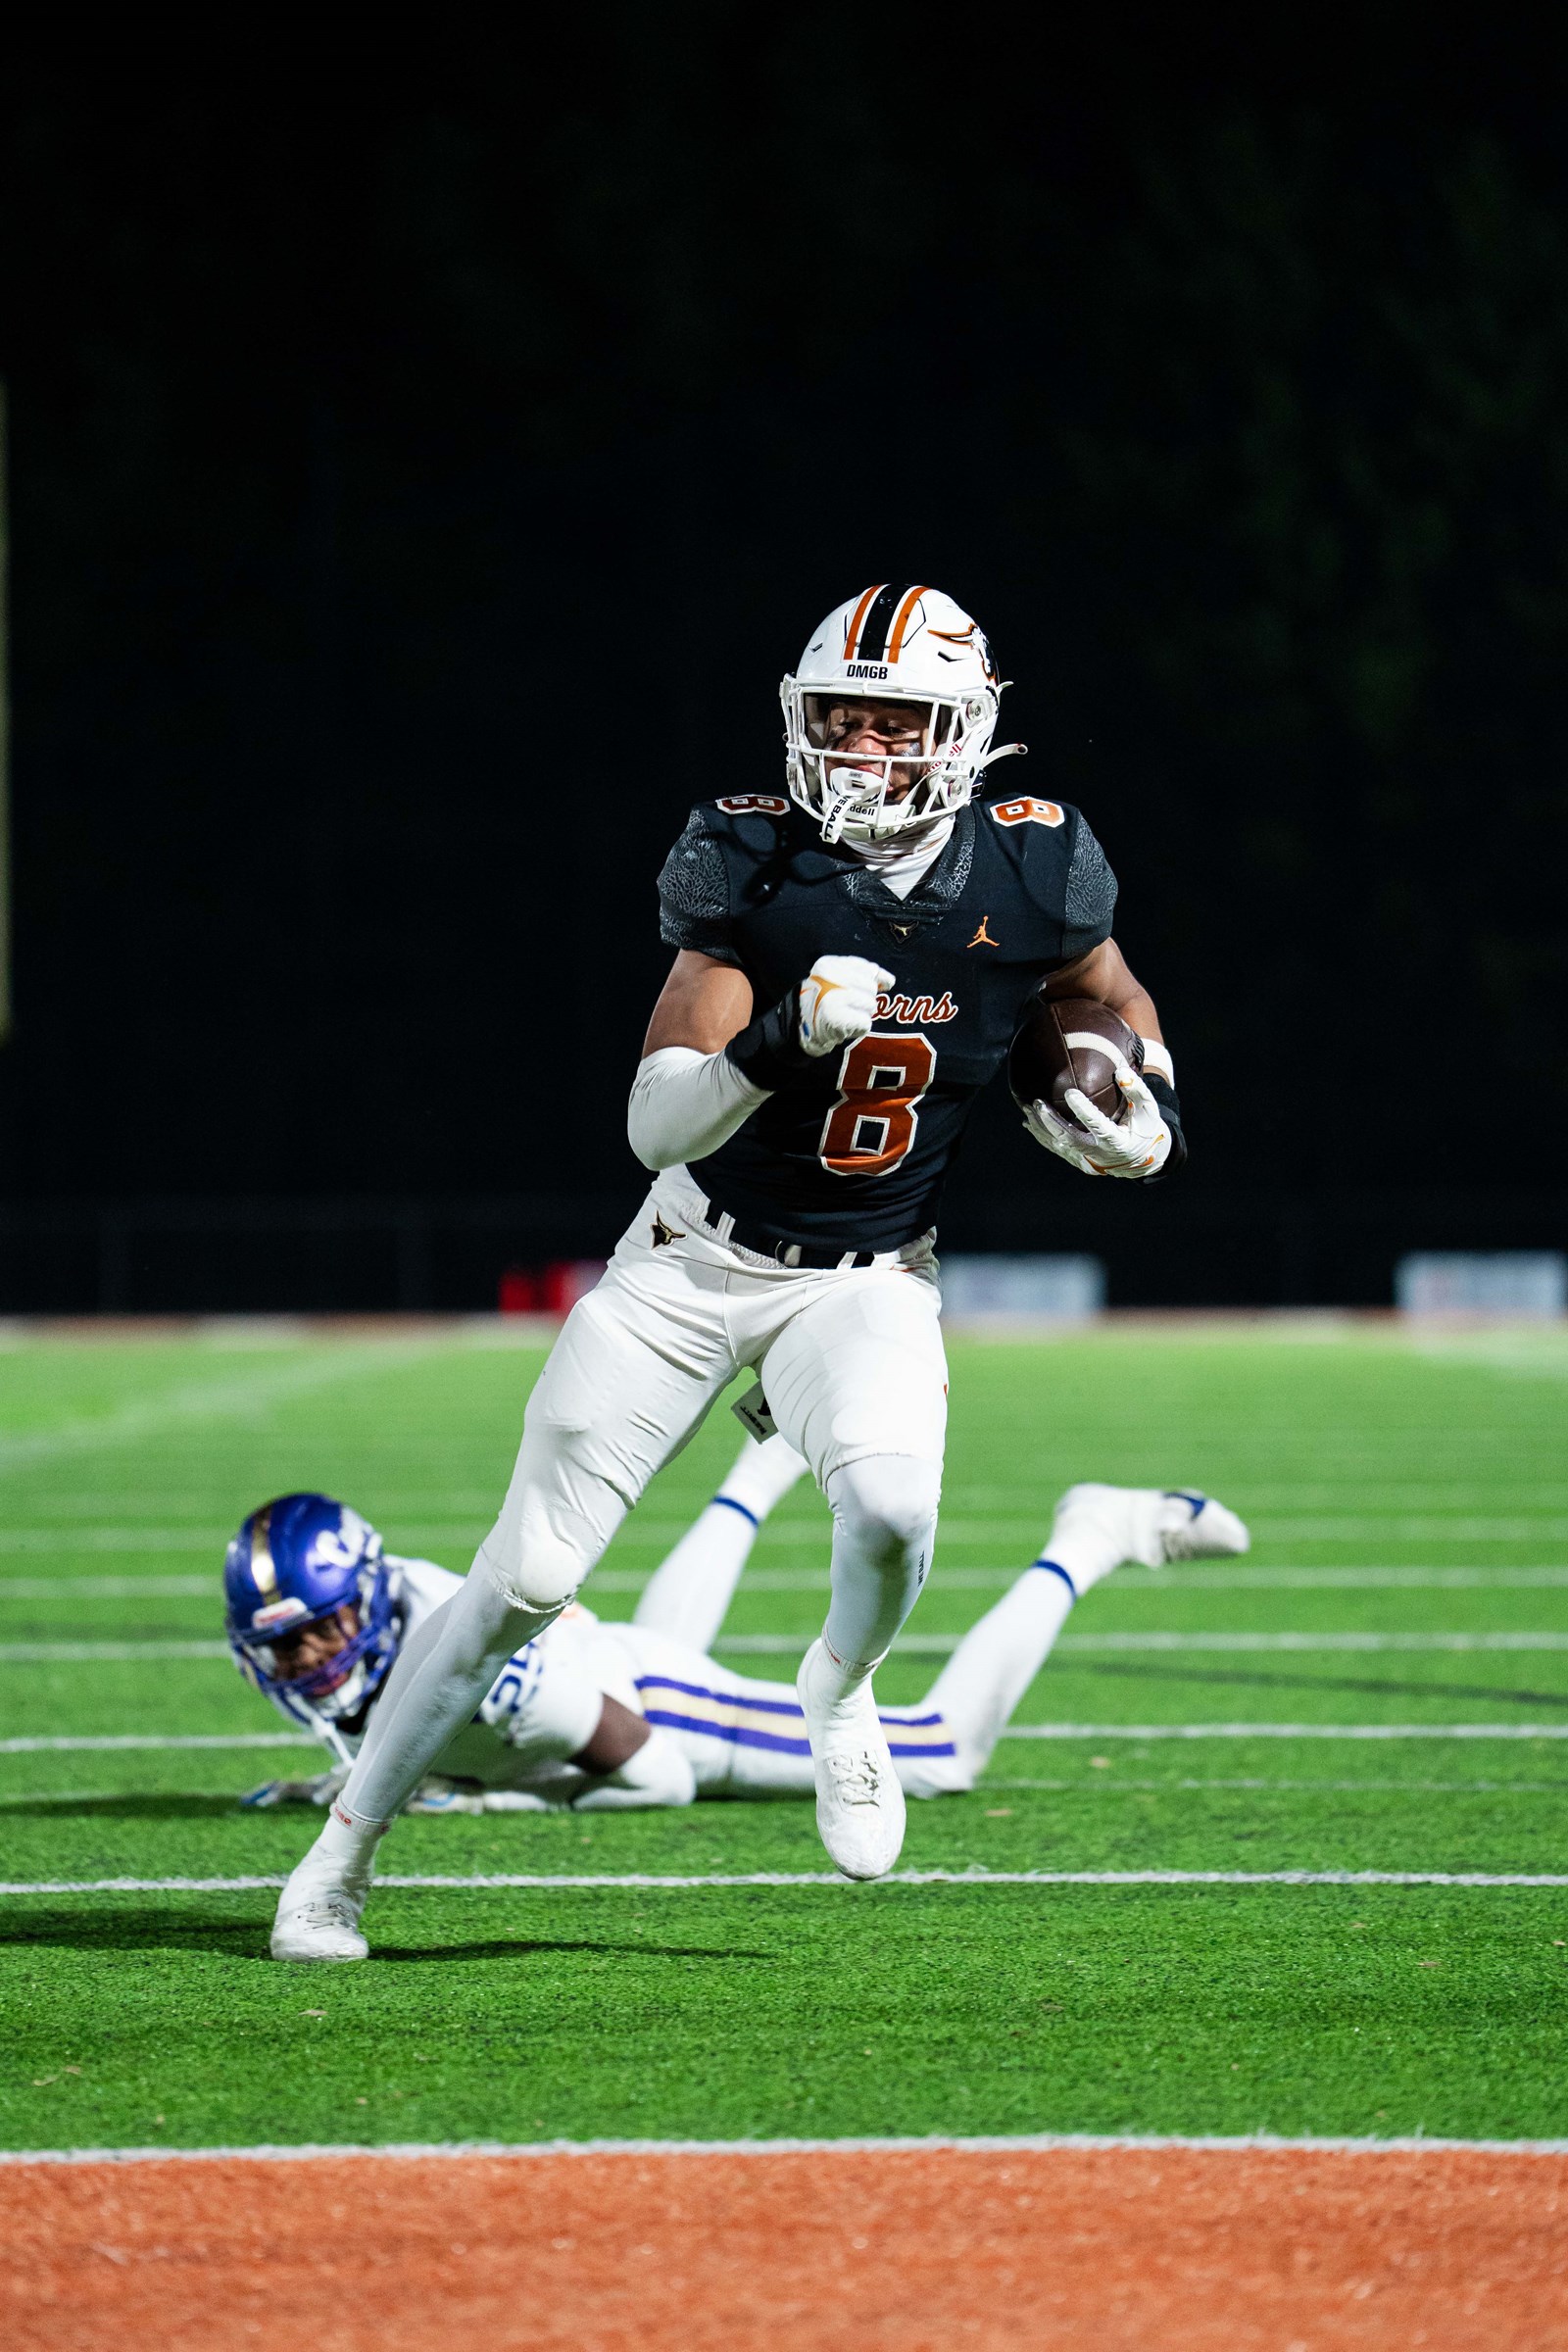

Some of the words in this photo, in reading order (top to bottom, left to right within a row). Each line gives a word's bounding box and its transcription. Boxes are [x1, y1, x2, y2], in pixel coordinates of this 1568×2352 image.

[847, 664, 889, 680] DMGB
[715, 794, 791, 815] 8
[848, 805, 875, 816] ddell
[989, 796, 1065, 828] 8
[824, 805, 842, 840] BALL
[871, 991, 959, 1024] orns
[817, 1032, 937, 1177] 8
